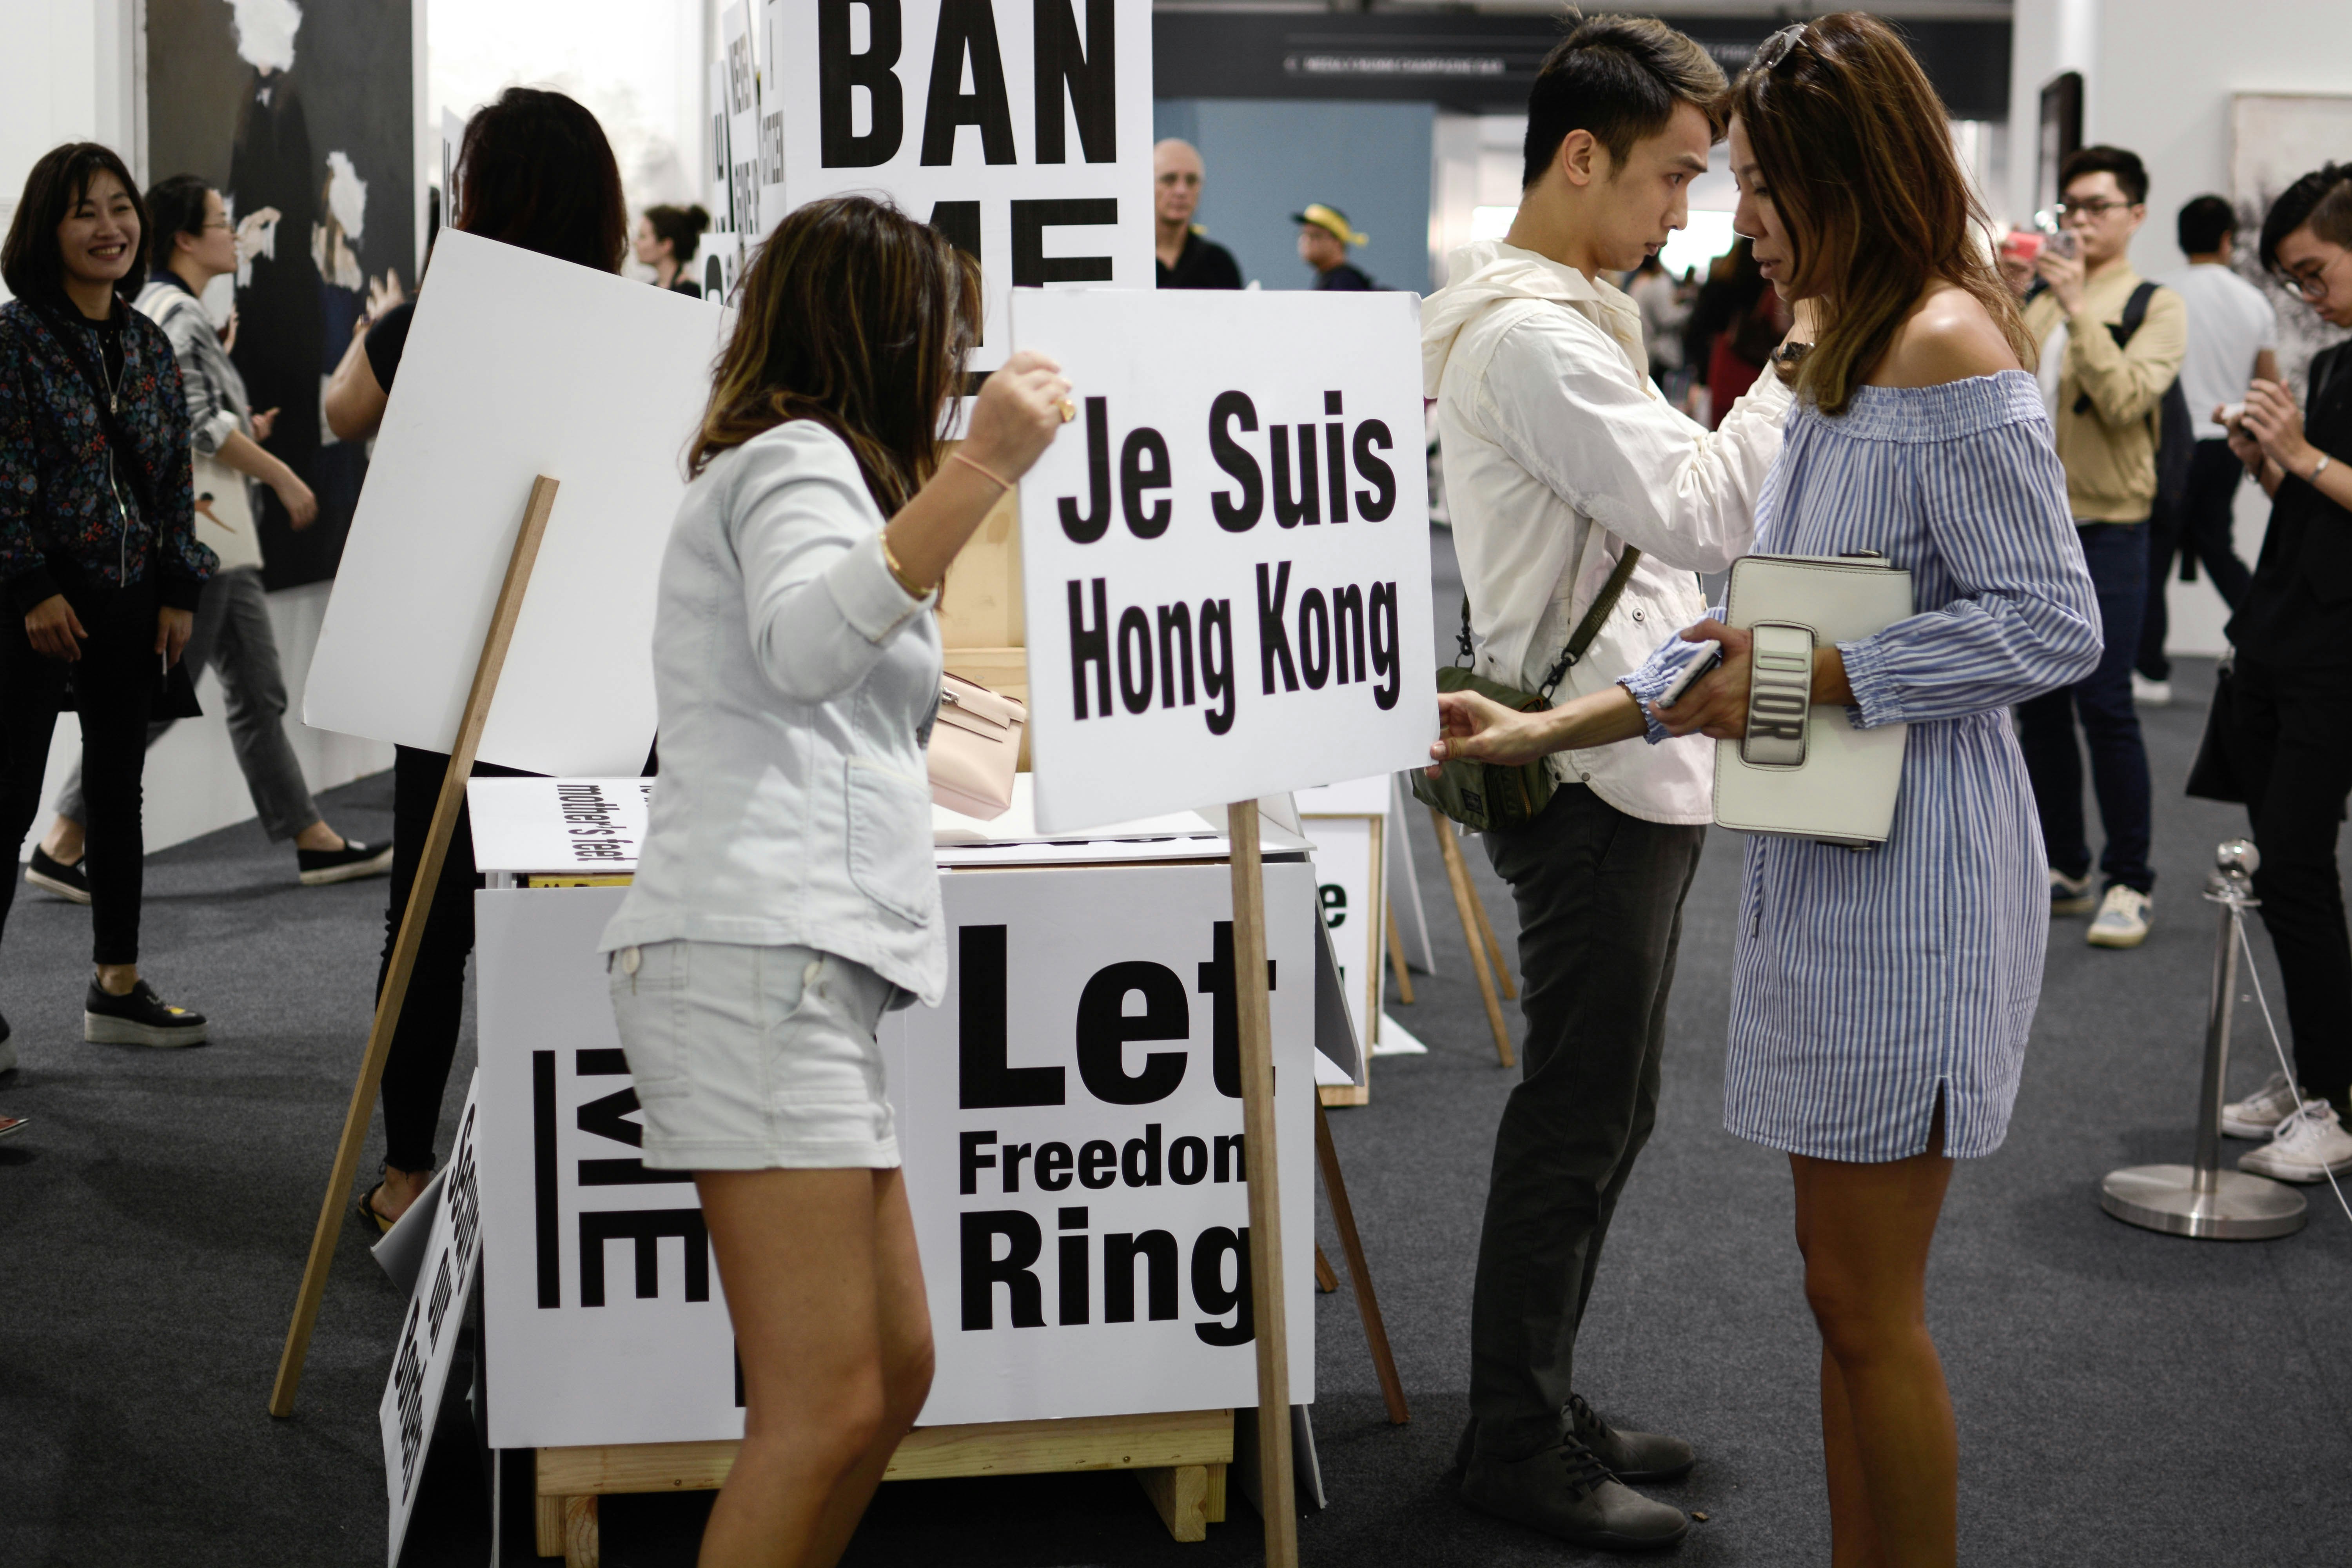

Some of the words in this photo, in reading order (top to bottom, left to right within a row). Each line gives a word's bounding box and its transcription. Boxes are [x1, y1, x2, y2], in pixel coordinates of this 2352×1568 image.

[818, 0, 1117, 169] BAN
[1057, 396, 1172, 544] Je
[1209, 390, 1396, 533] Suis
[1067, 577, 1235, 735] Hong
[1256, 561, 1400, 710] Kong
[1749, 649, 1809, 740] DIOR
[557, 784, 627, 835] mother's
[571, 839, 638, 861] feet
[958, 921, 1276, 1109] Let
[447, 1103, 479, 1297] Secure
[960, 1206, 1256, 1347] Ring
[394, 1295, 427, 1507] Borders
